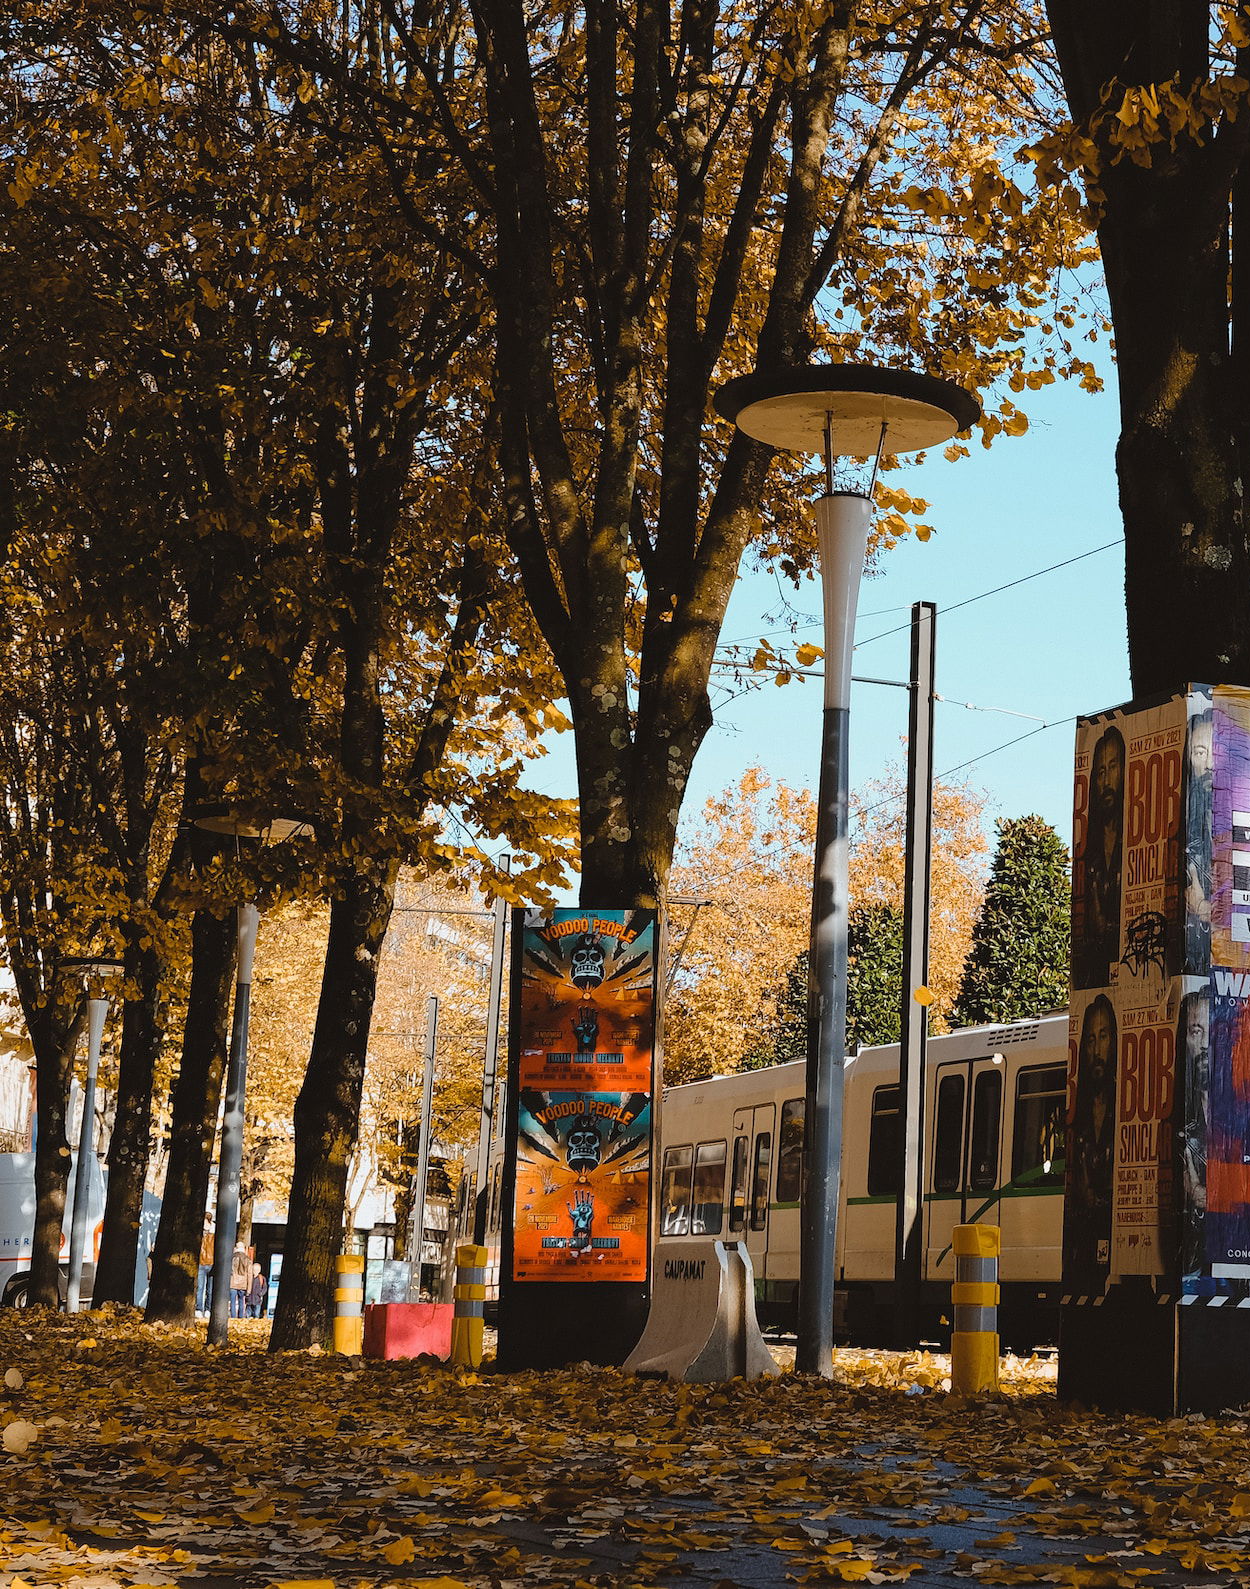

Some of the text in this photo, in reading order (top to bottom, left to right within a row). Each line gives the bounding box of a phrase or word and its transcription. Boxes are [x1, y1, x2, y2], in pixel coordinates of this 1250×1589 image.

[1144, 738, 1152, 751] 27
[1166, 729, 1181, 744] 2021
[1127, 749, 1181, 848] BOB
[540, 918, 637, 943] VOODOO PEOPLE
[1137, 1011, 1145, 1024] 27
[1120, 1028, 1174, 1122] BOB
[535, 1100, 634, 1126] VOODOO PEOPLE
